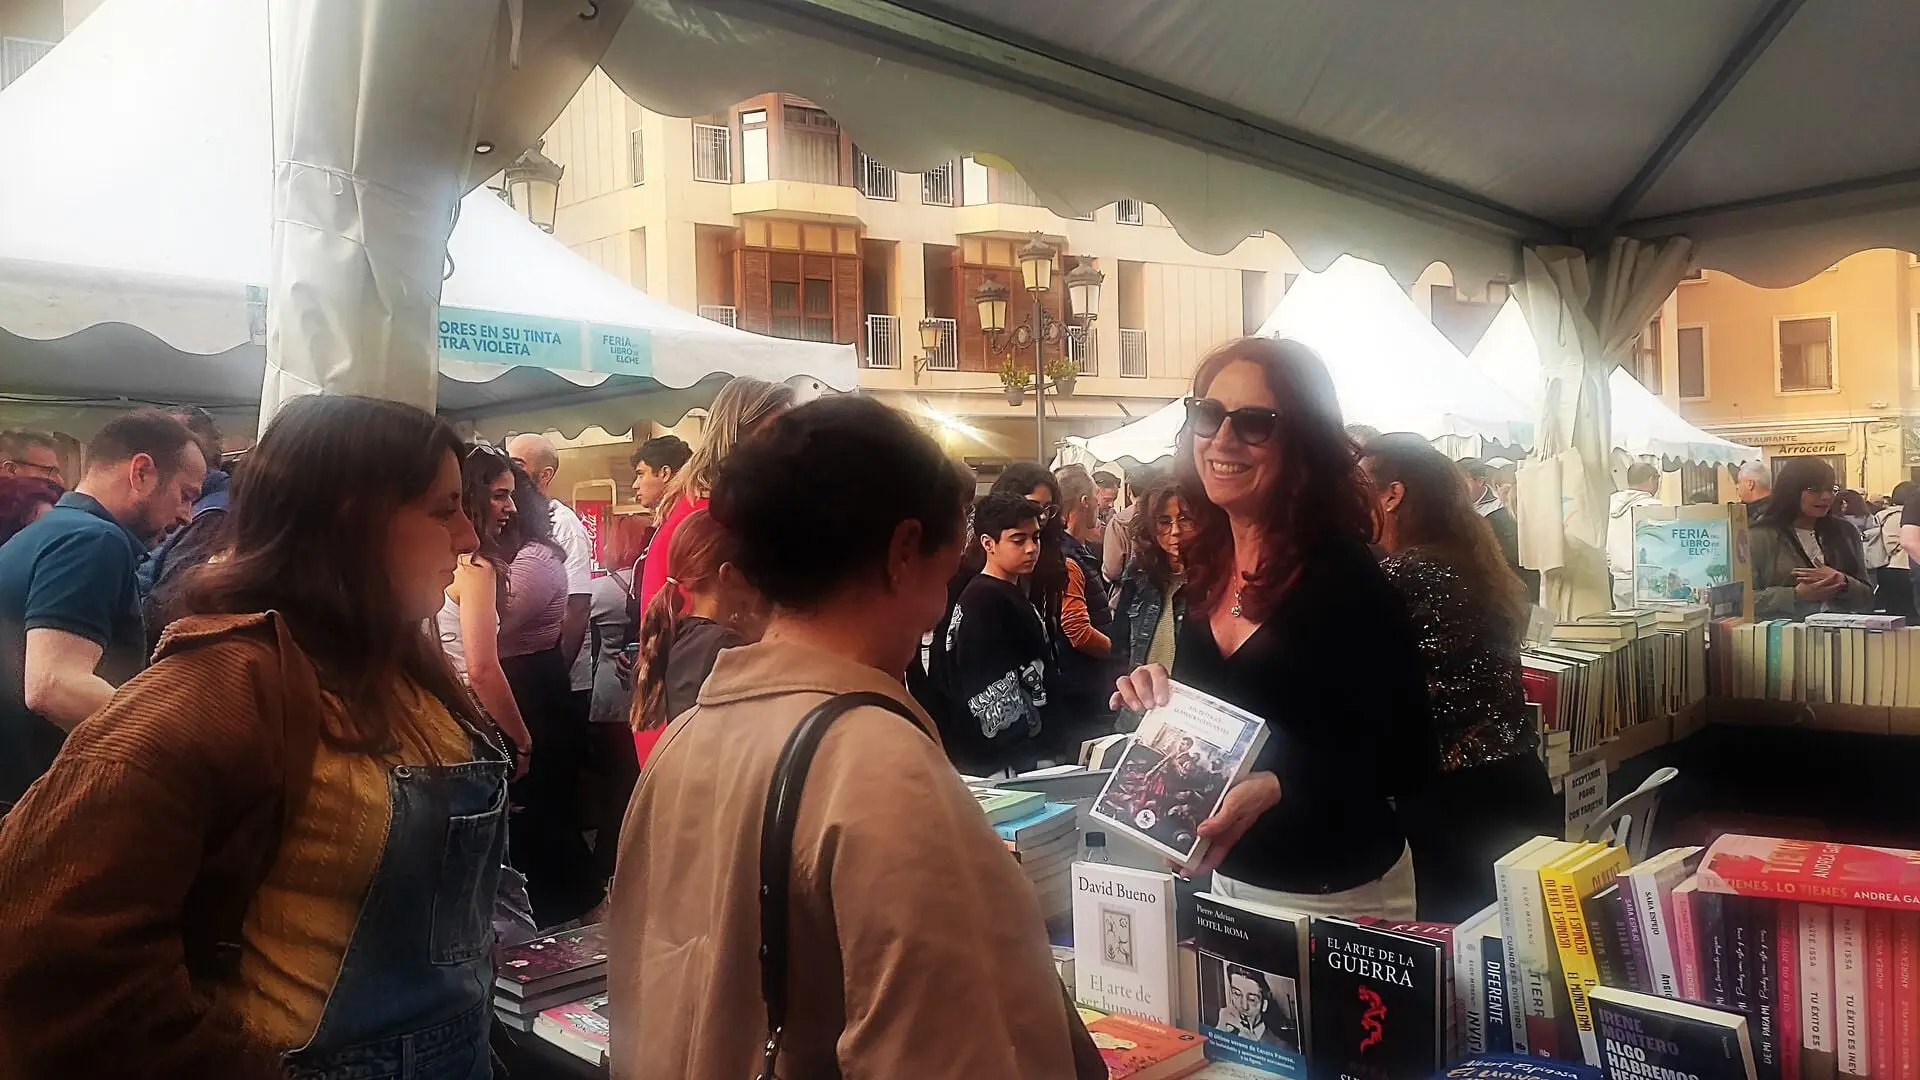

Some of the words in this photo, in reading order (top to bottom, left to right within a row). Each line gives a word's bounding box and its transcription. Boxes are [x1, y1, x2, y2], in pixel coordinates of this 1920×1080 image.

[438, 335, 470, 351] TRA
[473, 338, 531, 356] VIOLETA
[480, 325, 498, 339] EN
[502, 327, 520, 341] SU
[523, 329, 562, 345] TINTA
[602, 334, 632, 348] FERIA
[610, 346, 633, 356] LIBRO
[616, 355, 641, 365] ELCHE
[1671, 528, 1710, 539] FERIA
[1680, 539, 1711, 548] LIBRO
[1078, 875, 1114, 899] David
[1116, 882, 1157, 905] Bueno
[1522, 886, 1530, 909] ELOY
[1544, 879, 1562, 907] ALBERT
[1561, 885, 1579, 913] ALBERT
[1644, 891, 1655, 910] SARA
[1776, 882, 1796, 894] LO
[1853, 890, 1901, 903] ANDREA
[1214, 910, 1235, 923] Adrian
[1625, 898, 1634, 917] SARA
[1197, 916, 1223, 933] HOTEL
[1224, 925, 1249, 941] ROMA
[1524, 911, 1536, 945] MORENO
[1552, 911, 1572, 949] ESPINOSA
[1629, 917, 1641, 942] ESPEJO
[1649, 911, 1660, 936] ESPEJO
[1569, 917, 1588, 955] ESPINOSA
[1327, 936, 1341, 950] EL
[1344, 941, 1375, 958] ARTE
[1379, 949, 1395, 963] DE
[1399, 953, 1415, 968] LA
[1808, 946, 1817, 968] ISSA
[1845, 949, 1853, 970] ISSA
[1327, 951, 1414, 988] GUERRA
[1567, 971, 1579, 980] EL
[1875, 957, 1885, 990] ANDREA
[1900, 957, 1909, 989] ANDREA
[1090, 974, 1103, 992] El
[1107, 981, 1133, 999] arte
[1135, 984, 1152, 1005] de
[1486, 960, 1504, 1025] DIFERENTE
[1506, 935, 1516, 968] CUANDO
[1511, 987, 1522, 1029] DIVERTIDO
[1570, 983, 1587, 1013] MUNDO
[1810, 991, 1819, 1003] TU
[1846, 994, 1855, 1007] TU
[1598, 1007, 1644, 1034] IRENE
[1761, 1015, 1772, 1037] PARA
[1810, 1005, 1821, 1033] ÉXITO
[1846, 1008, 1856, 1037] ÉXITO
[1602, 1023, 1680, 1057] MONTERO
[1606, 1038, 1646, 1062] ALGO
[1812, 1034, 1821, 1046] ES
[1847, 1038, 1857, 1050] ES
[1459, 1059, 1513, 1070] Albert
[1512, 1062, 1578, 1080] Espinosa
